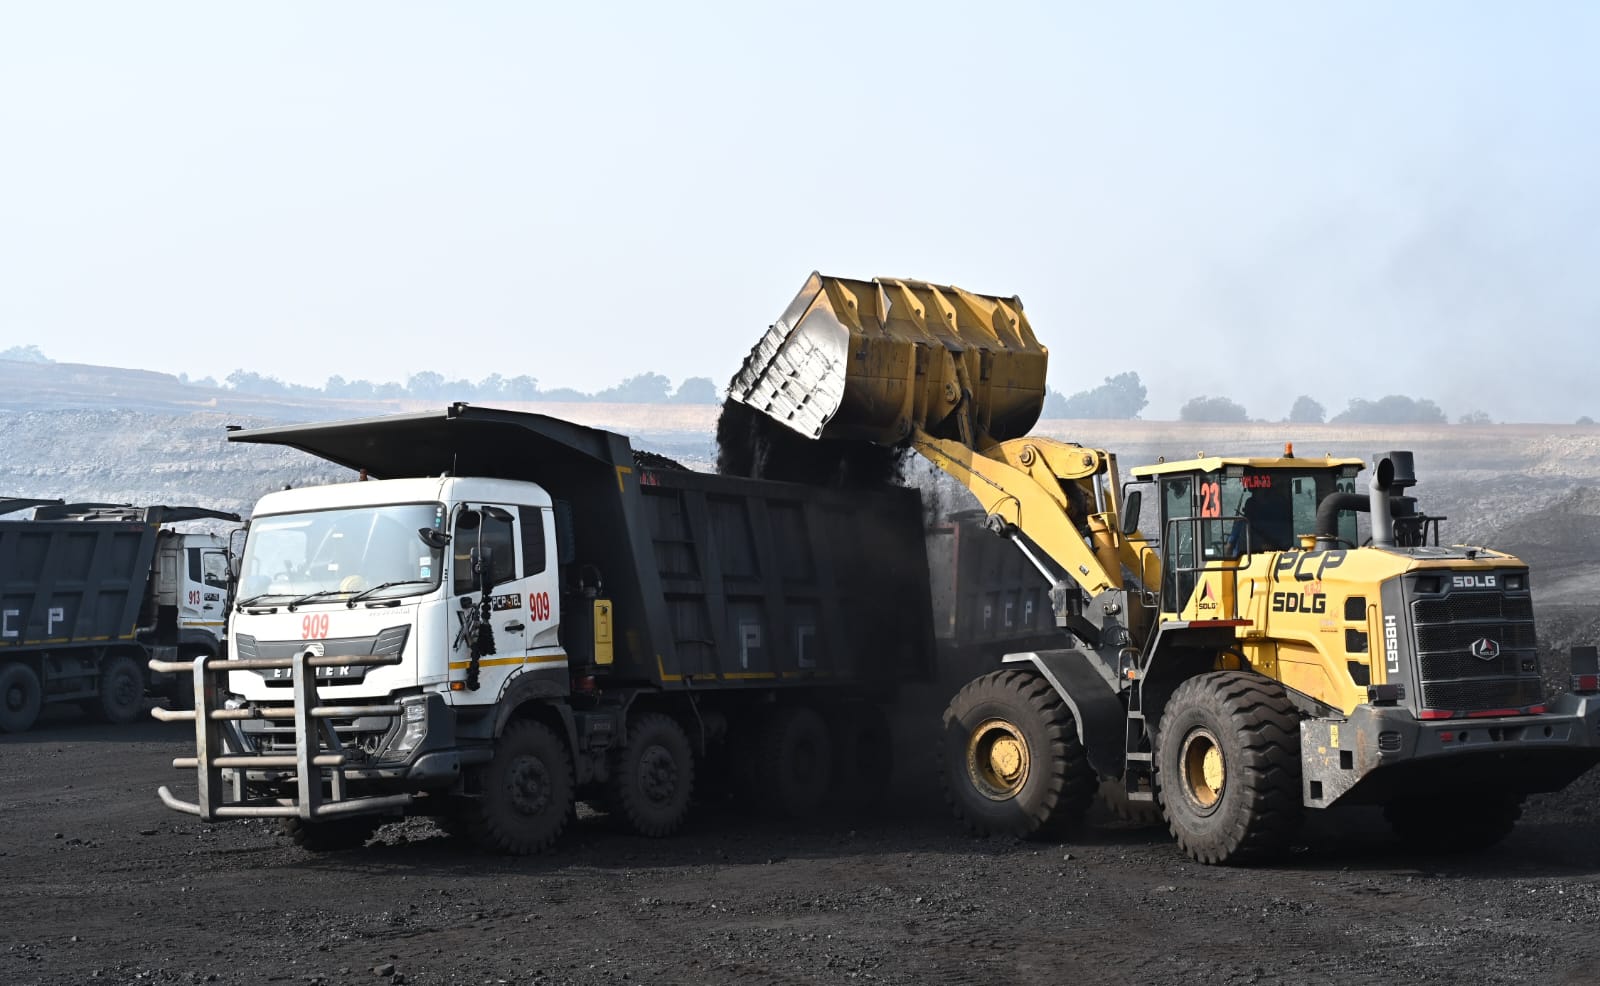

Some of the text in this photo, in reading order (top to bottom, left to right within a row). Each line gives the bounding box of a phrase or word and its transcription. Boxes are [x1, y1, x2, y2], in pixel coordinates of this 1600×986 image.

[1200, 482, 1220, 517] 23
[1273, 551, 1347, 583] PCP
[1452, 575, 1496, 587] SDLG
[188, 590, 201, 605] 913
[529, 591, 550, 622] 909
[1272, 592, 1326, 613] SDLG
[302, 614, 329, 639] 909
[1384, 615, 1399, 673] L958H
[273, 666, 350, 678] EIER
